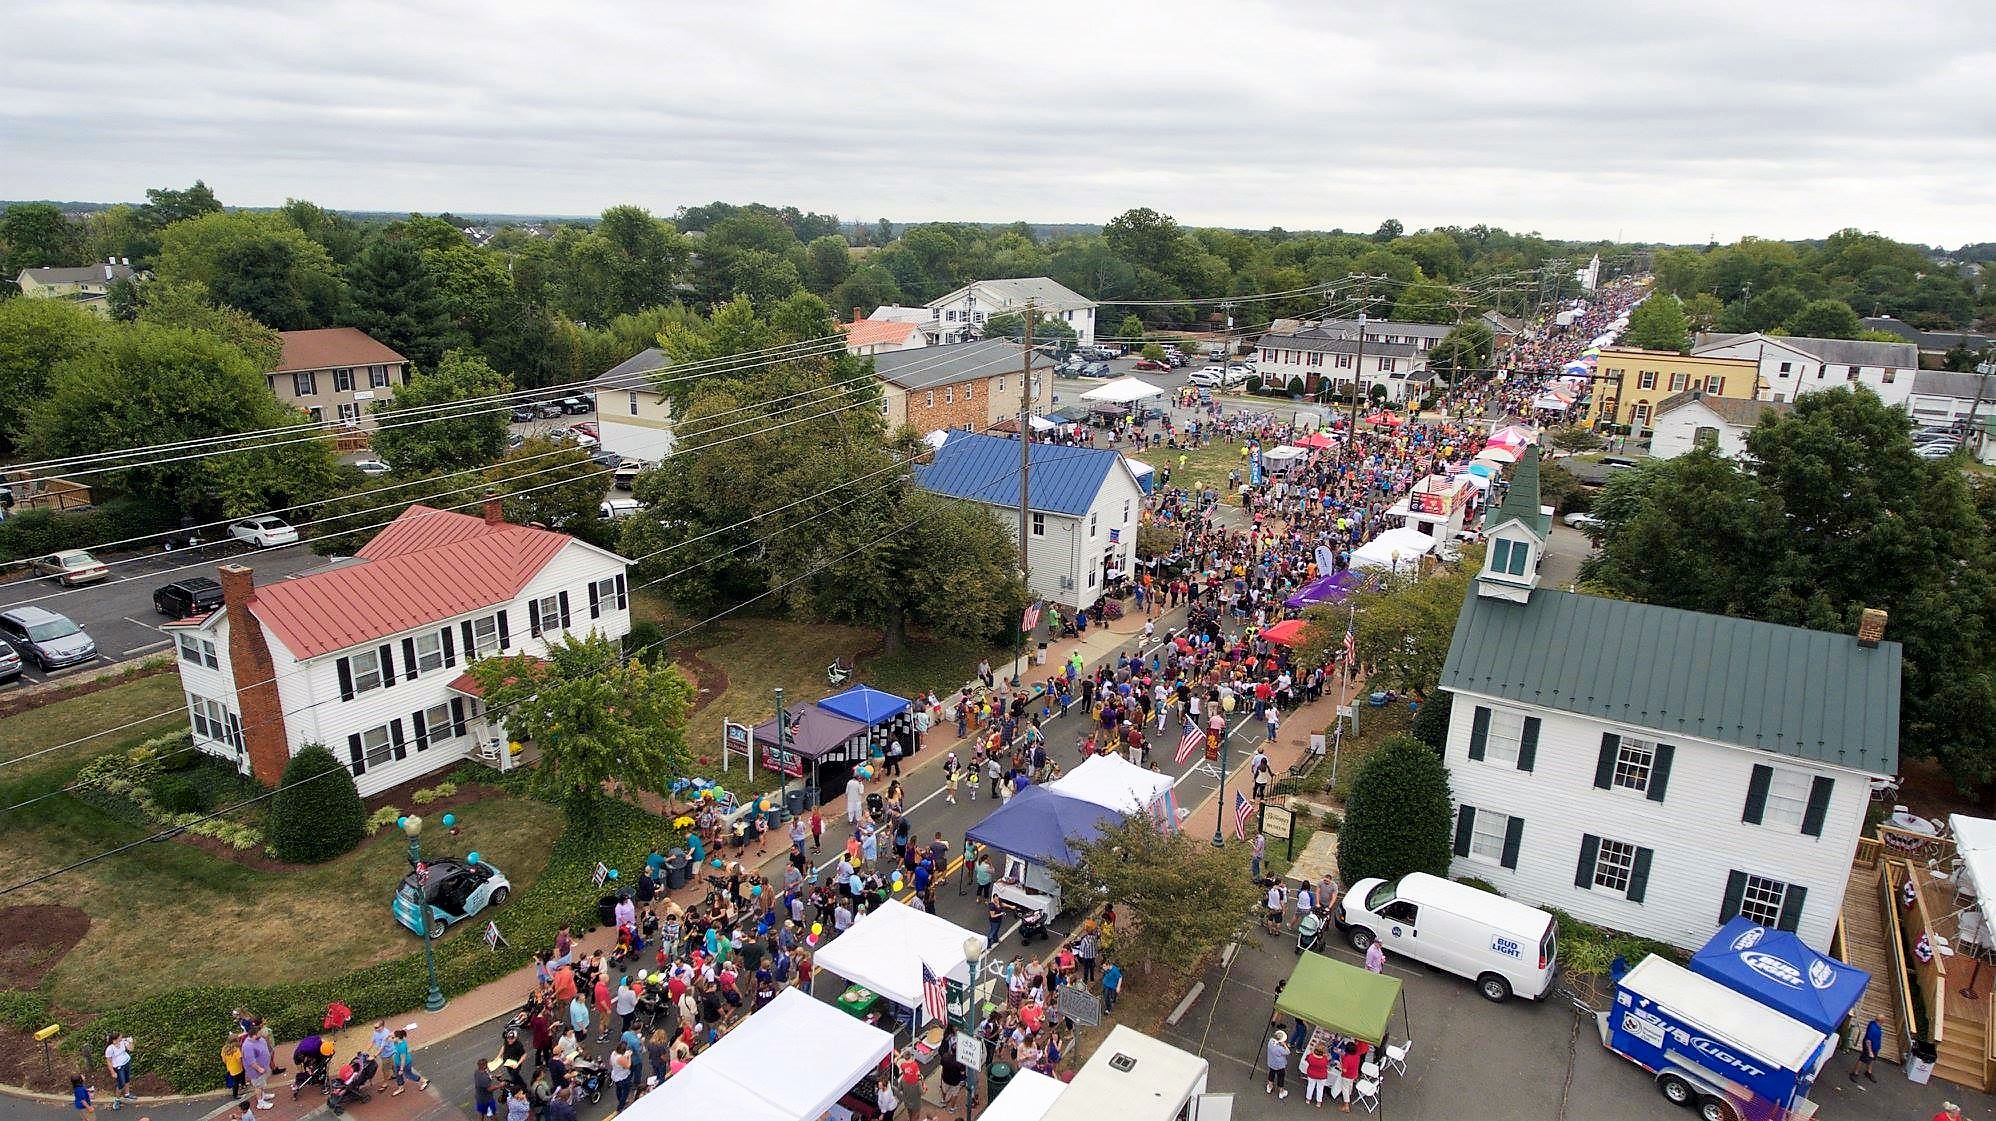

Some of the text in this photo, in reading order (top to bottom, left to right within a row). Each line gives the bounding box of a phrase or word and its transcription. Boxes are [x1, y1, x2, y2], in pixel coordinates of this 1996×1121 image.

[1492, 943, 1520, 957] LIGHT
[1497, 938, 1518, 949] BUD
[1698, 1041, 1766, 1076] LIGHT
